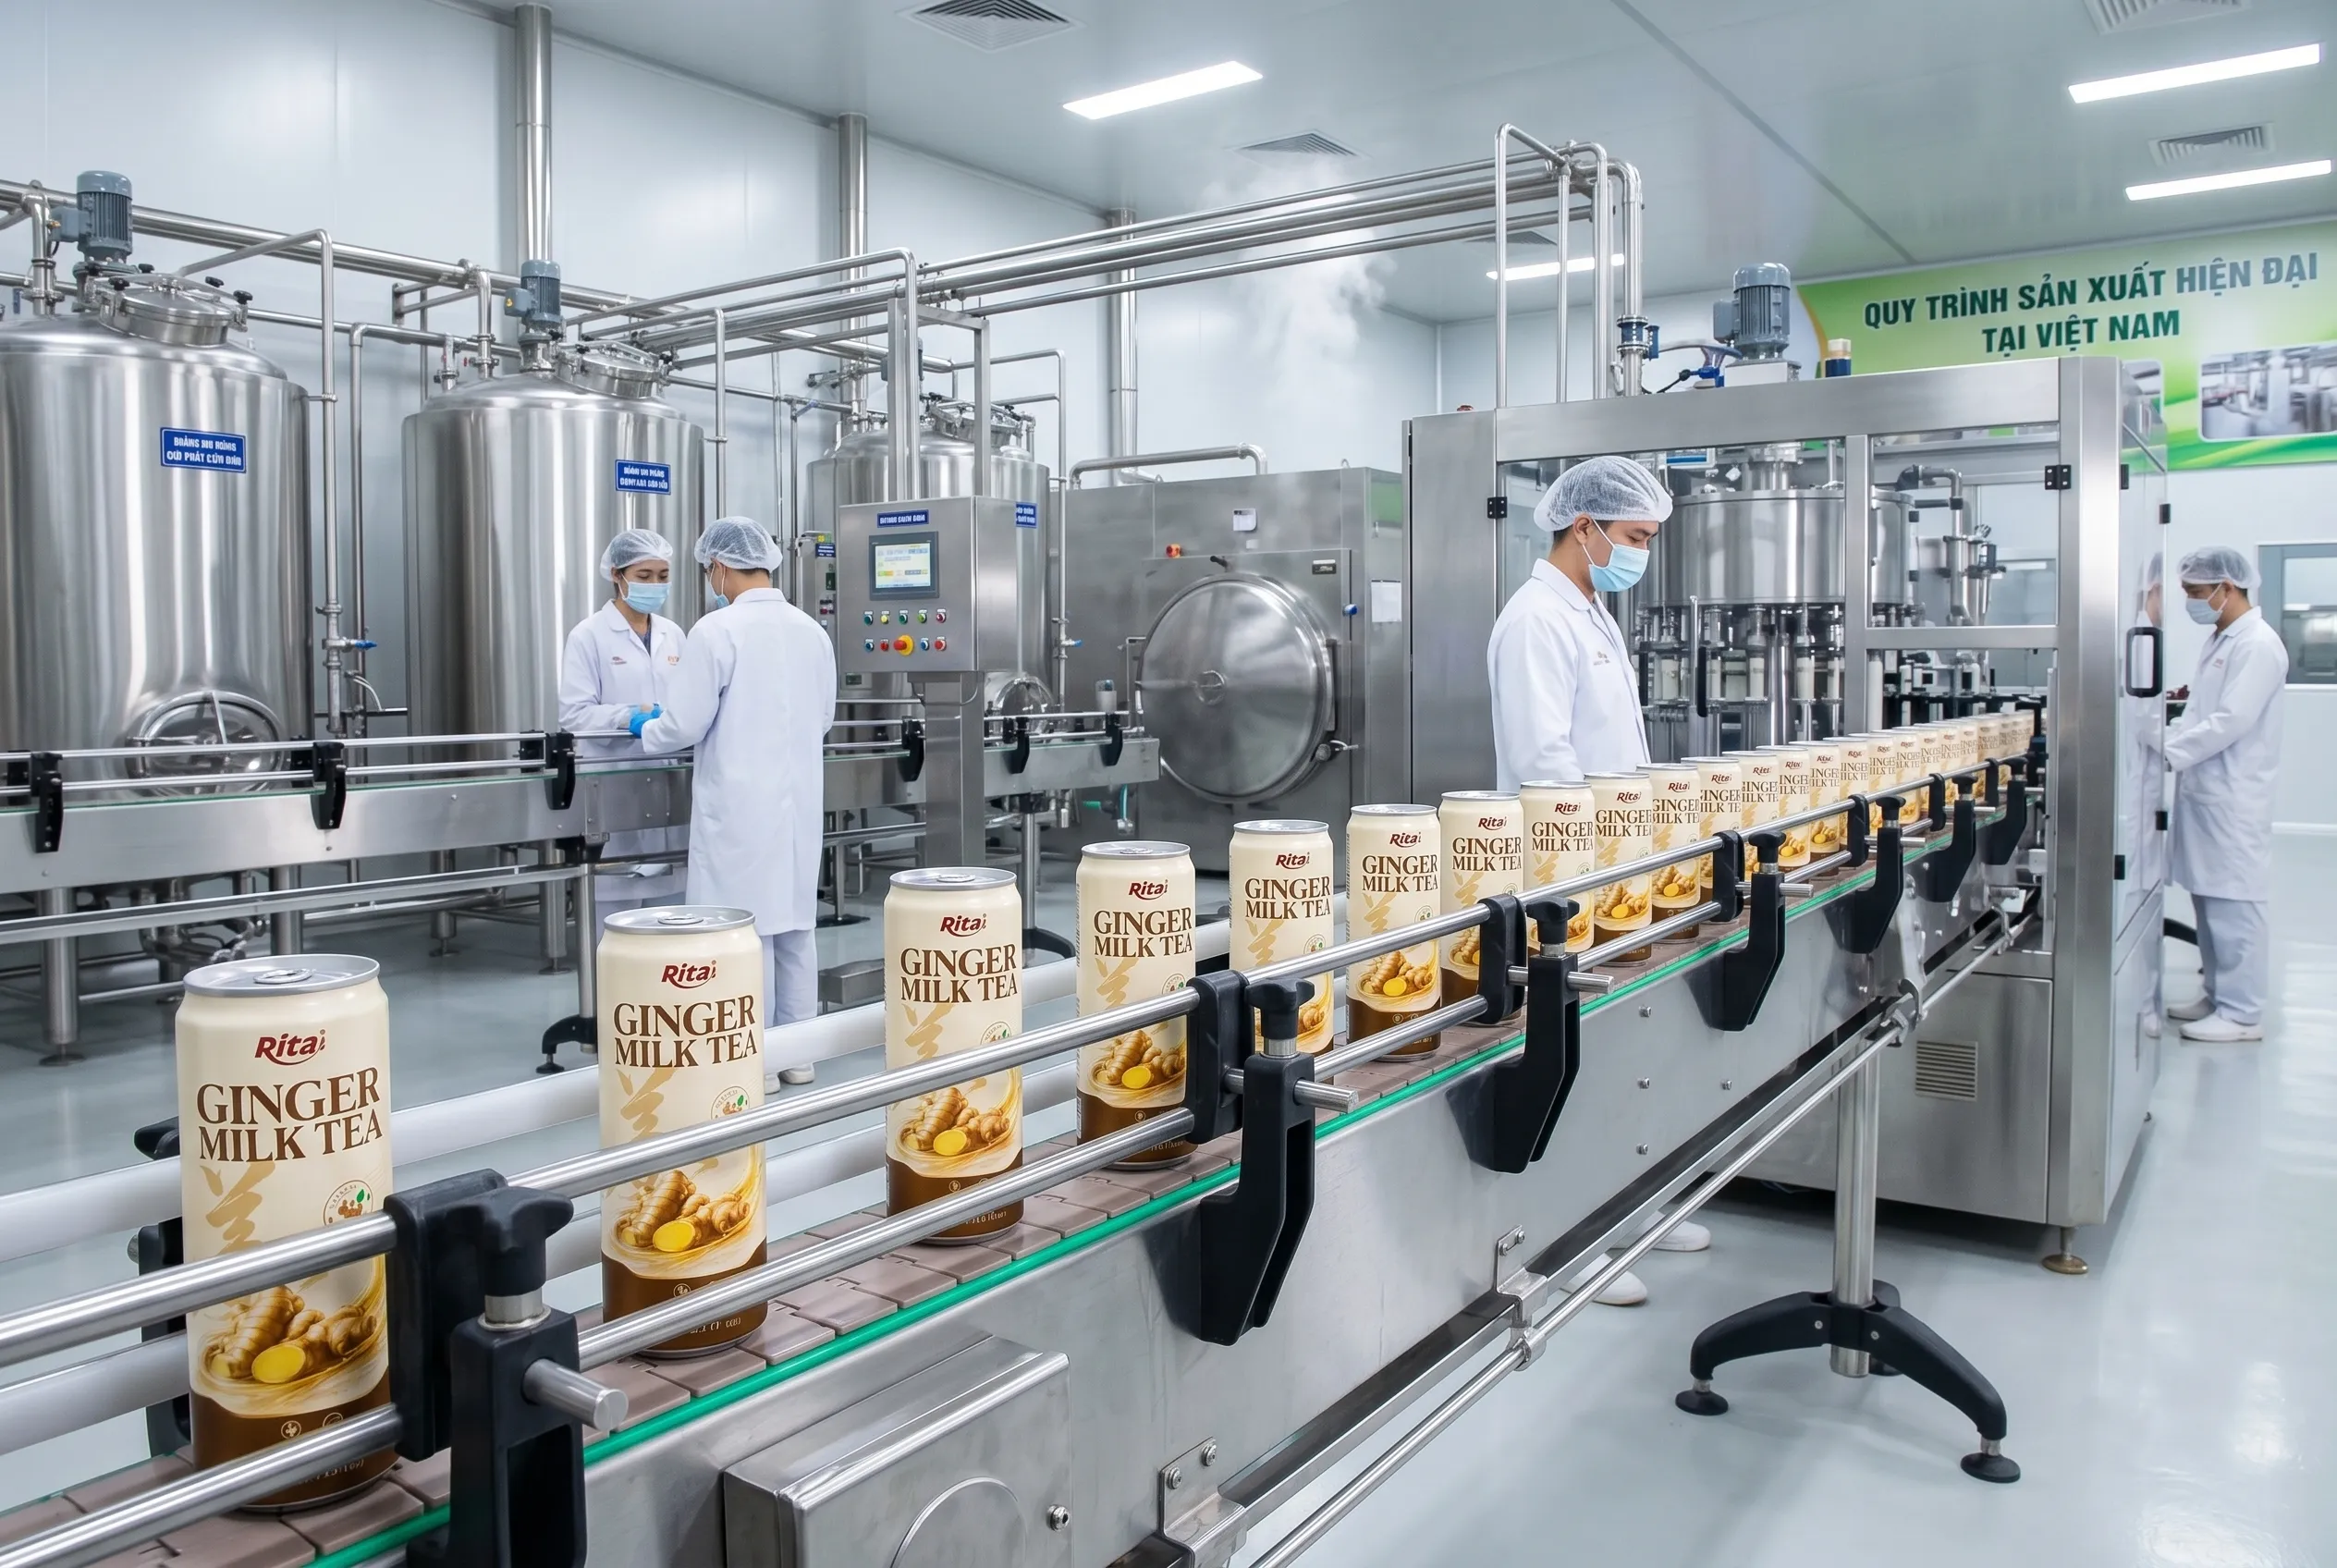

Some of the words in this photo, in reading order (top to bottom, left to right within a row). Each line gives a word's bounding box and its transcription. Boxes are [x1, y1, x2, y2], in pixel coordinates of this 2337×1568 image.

[1865, 298, 1916, 329] QUY
[1926, 287, 2008, 321] TRÌNH
[2018, 274, 2077, 311] SẢN
[2087, 261, 2166, 303] XUẤT
[2176, 257, 2251, 296] HIỆN
[2261, 252, 2318, 288] ĐẠI
[1982, 325, 2025, 357] TẠI
[2036, 313, 2098, 352] VIỆT
[2109, 309, 2180, 342] NAM
[1478, 816, 1504, 831] Rita
[1532, 821, 1593, 838] GINGER
[1595, 825, 1632, 837] MILK
[1452, 836, 1522, 855] GINGER
[1532, 838, 1571, 851] MILK
[1276, 853, 1307, 870] Rita
[1362, 853, 1438, 876] GINGER
[1452, 855, 1497, 872] MILK
[1499, 855, 1522, 871] TEA
[1128, 881, 1165, 900] Rita
[1244, 876, 1330, 900] GINGER
[1362, 875, 1410, 893] MILK
[1413, 874, 1438, 892] TEA
[1245, 900, 1298, 920] MILK
[1302, 898, 1331, 918] TEA
[939, 915, 982, 937] Rita
[1094, 907, 1193, 936] GINGER
[1094, 935, 1156, 958] MILK
[1159, 932, 1193, 957] TEA
[900, 943, 1018, 977] GINGER
[661, 962, 710, 989] Rita
[900, 976, 973, 1004] MILK
[977, 973, 1018, 1002] TEA
[613, 994, 756, 1037] GINGER
[254, 1032, 320, 1066] Rita
[614, 1037, 700, 1068] MILK
[705, 1029, 758, 1065] TEA
[196, 1066, 381, 1125] GINGER
[199, 1125, 307, 1163] MILK
[314, 1109, 383, 1156] TEA
